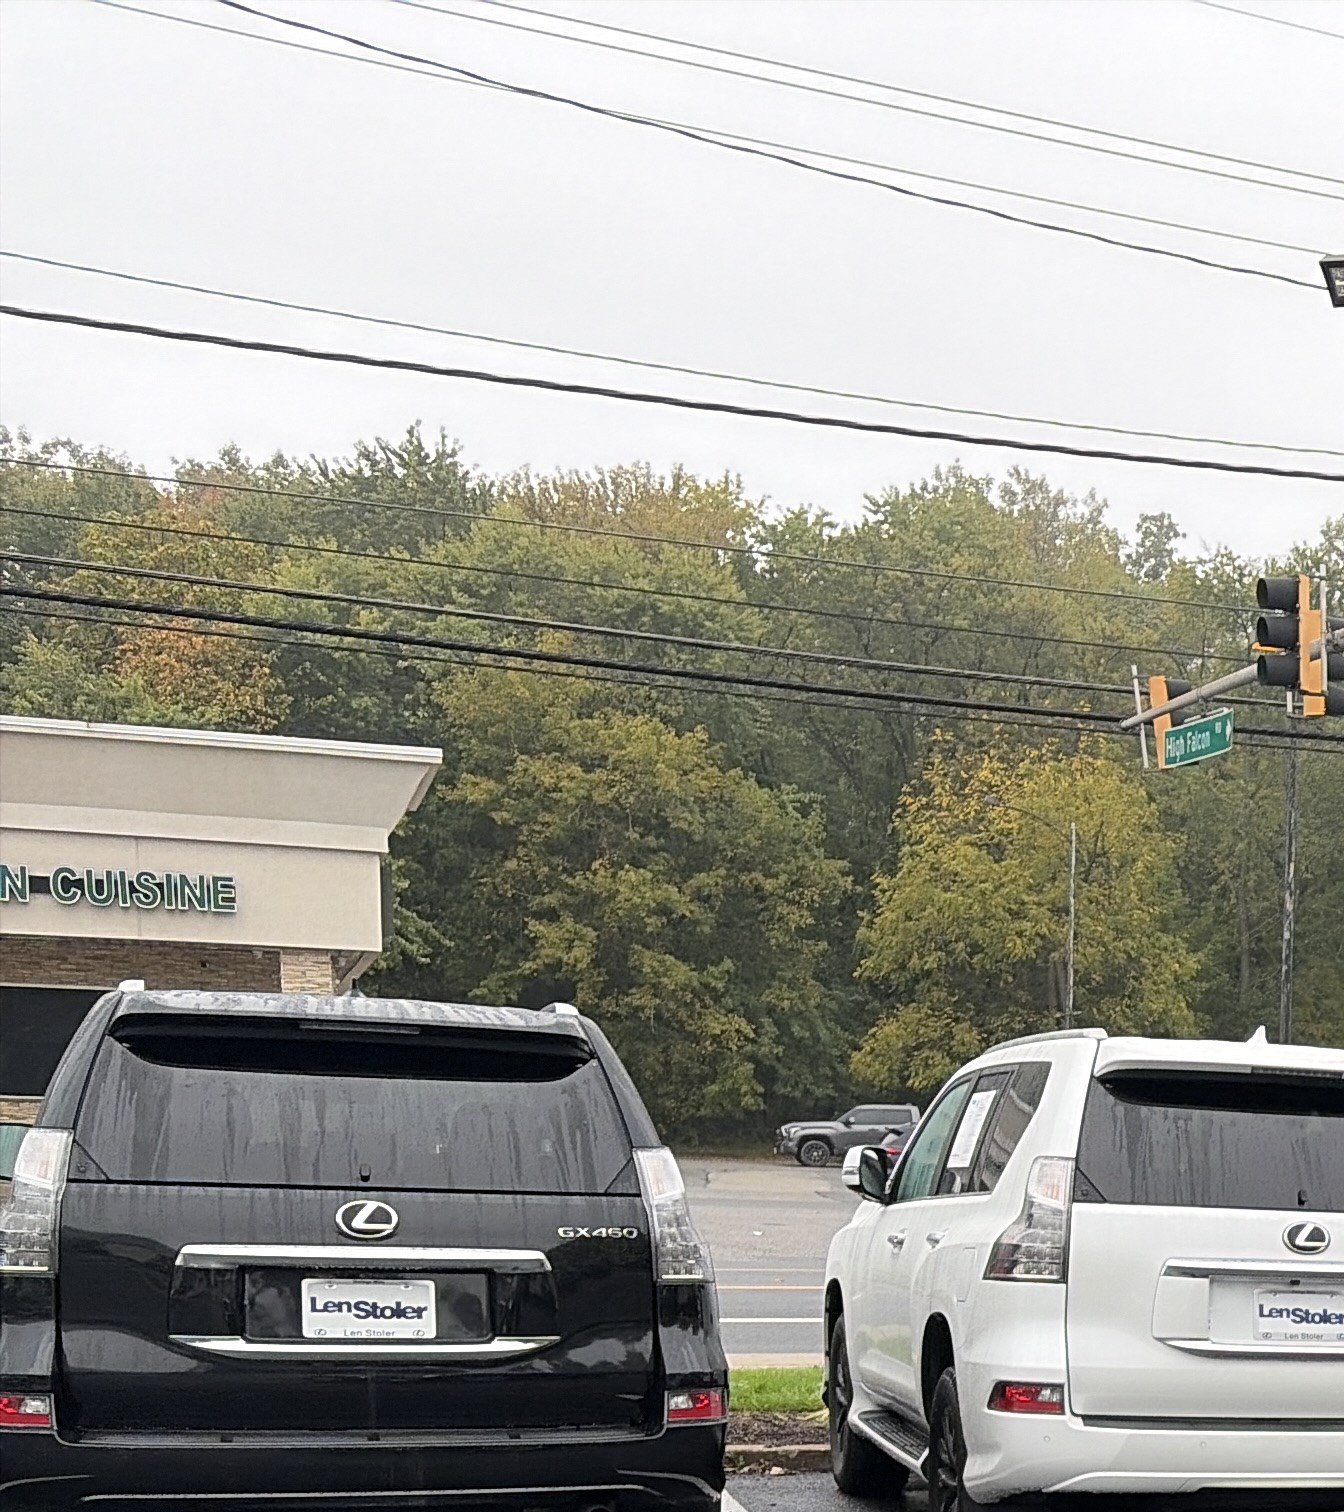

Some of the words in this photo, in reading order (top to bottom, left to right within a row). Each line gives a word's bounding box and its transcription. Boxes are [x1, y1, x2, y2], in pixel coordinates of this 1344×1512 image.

[1166, 735, 1185, 762] High
[1187, 731, 1211, 753] Falcon
[51, 866, 237, 913] CUISINE
[343, 1329, 362, 1337] Len
